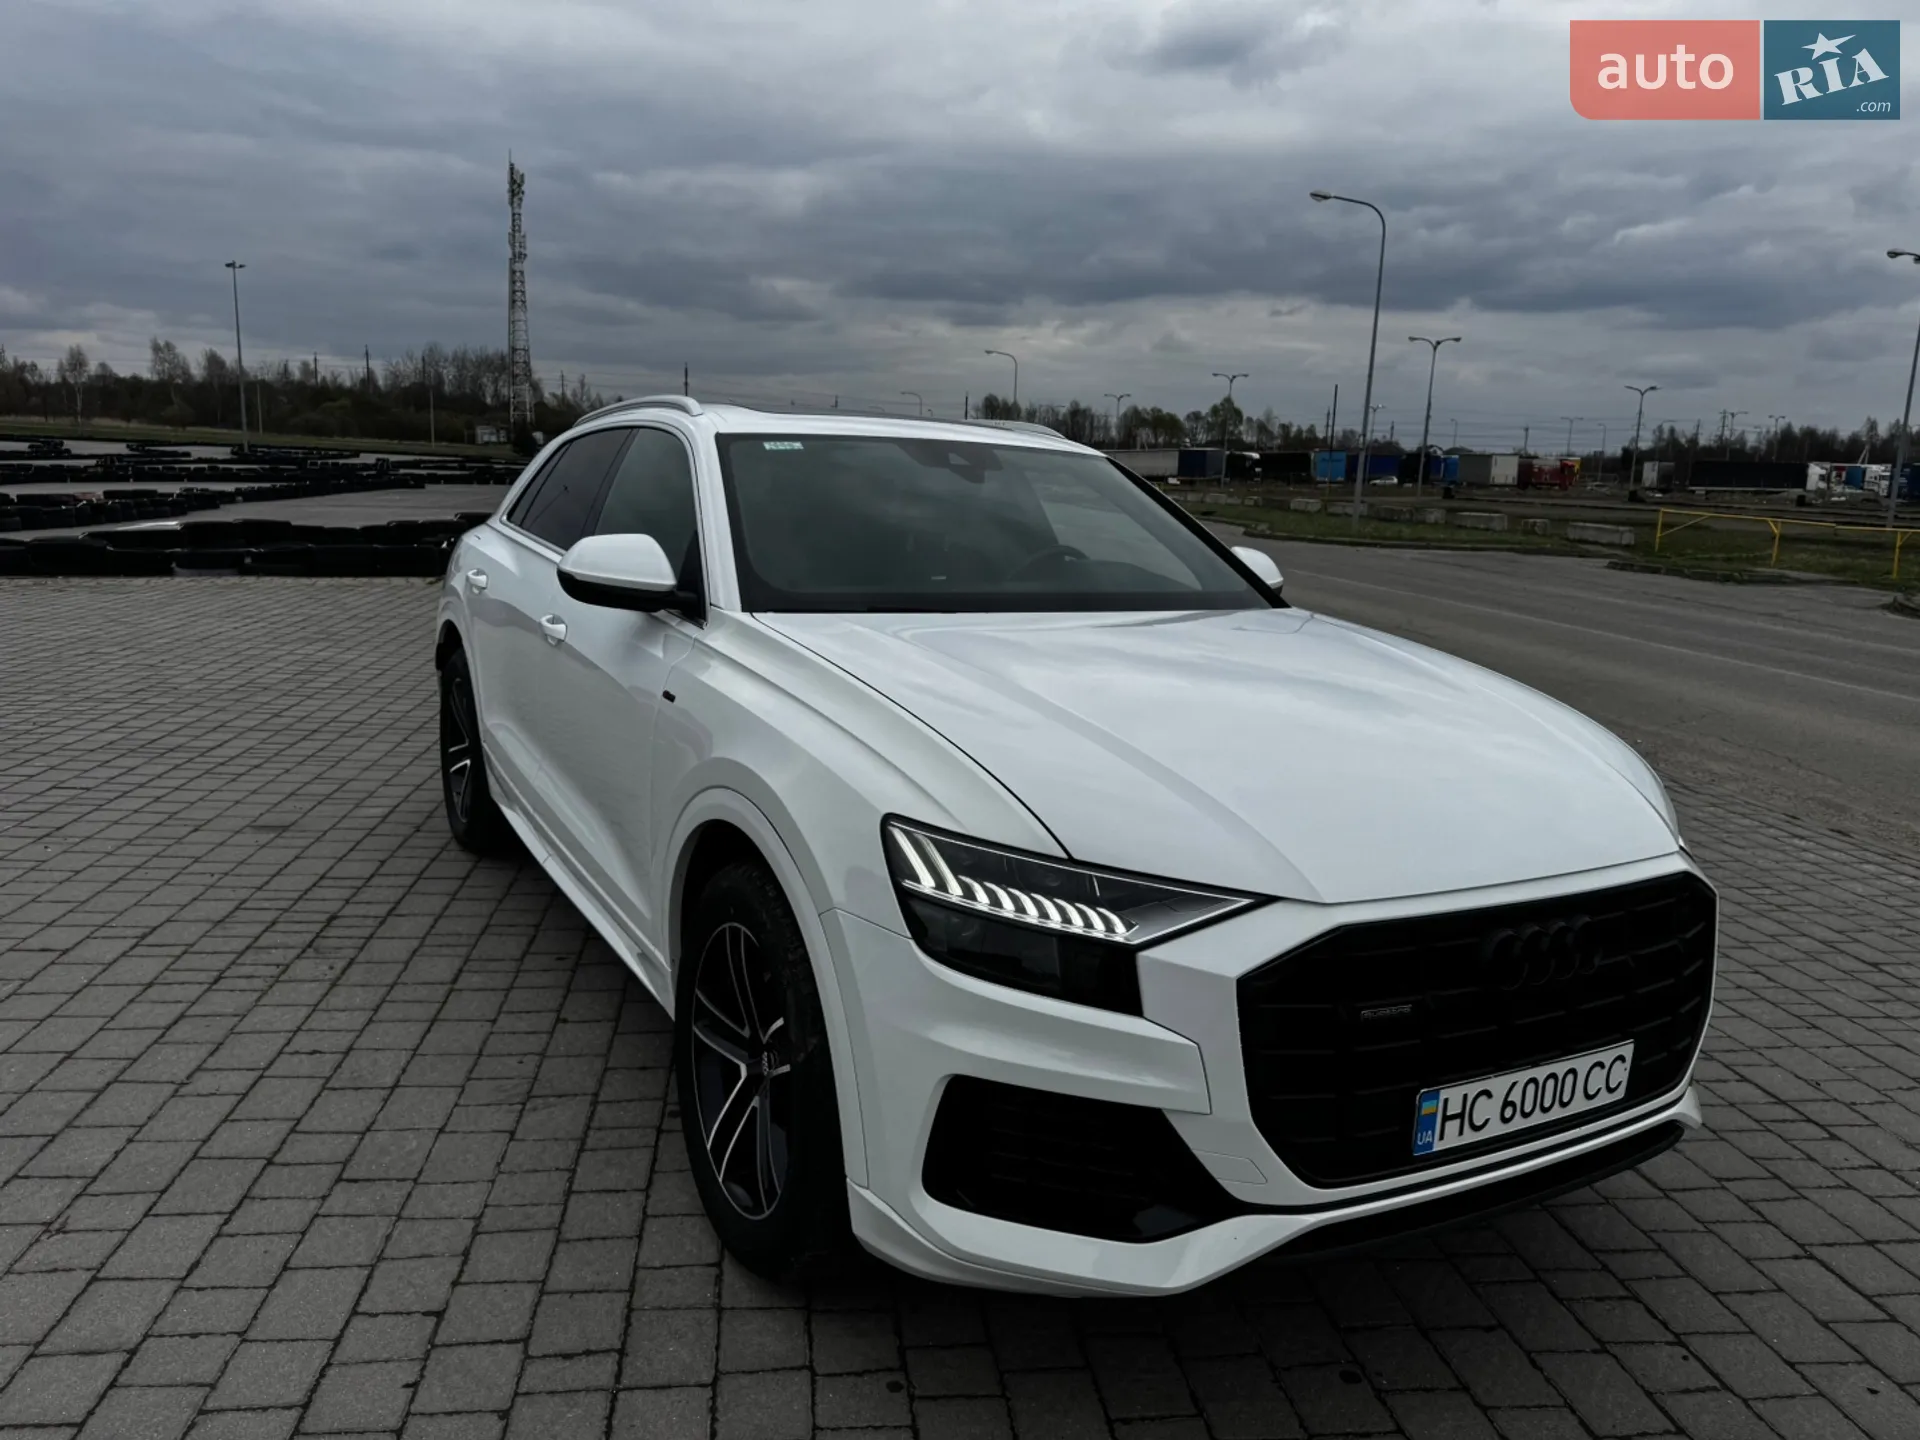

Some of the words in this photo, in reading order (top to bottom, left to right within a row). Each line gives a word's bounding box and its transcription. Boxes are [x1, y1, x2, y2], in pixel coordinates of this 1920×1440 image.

[1438, 1088, 1494, 1141] HC
[1500, 1066, 1579, 1125] 6000
[1582, 1053, 1627, 1101] CC
[1417, 1130, 1434, 1146] UA
